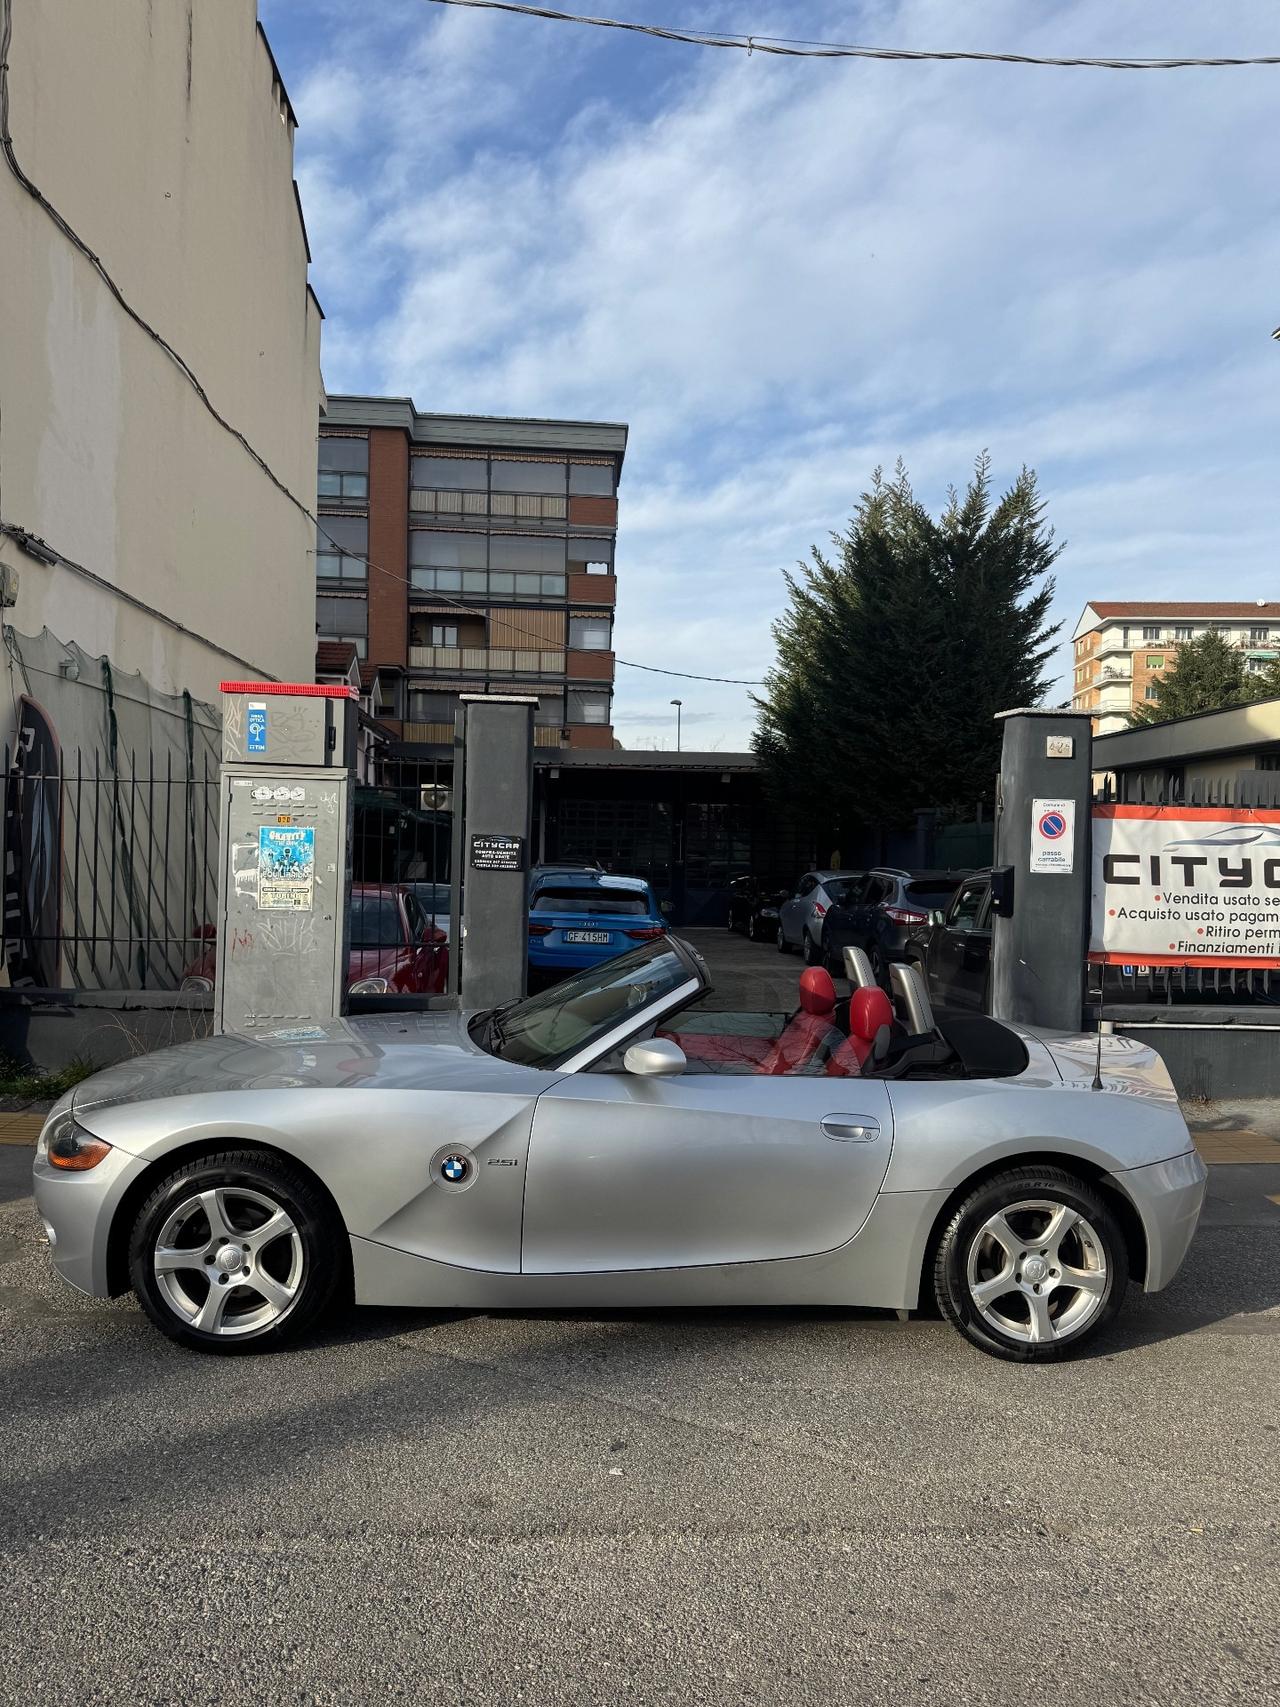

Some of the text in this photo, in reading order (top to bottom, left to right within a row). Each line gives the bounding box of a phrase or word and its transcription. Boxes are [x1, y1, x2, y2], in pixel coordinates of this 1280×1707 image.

[473, 841, 520, 849] CITYCAR
[1163, 892, 1218, 904] Vendita
[1223, 894, 1260, 906] usato
[1118, 907, 1278, 924] Acquisto usato pagam
[1206, 925, 1280, 940] Ritiro perm
[1177, 941, 1274, 954] Finanziamenti
